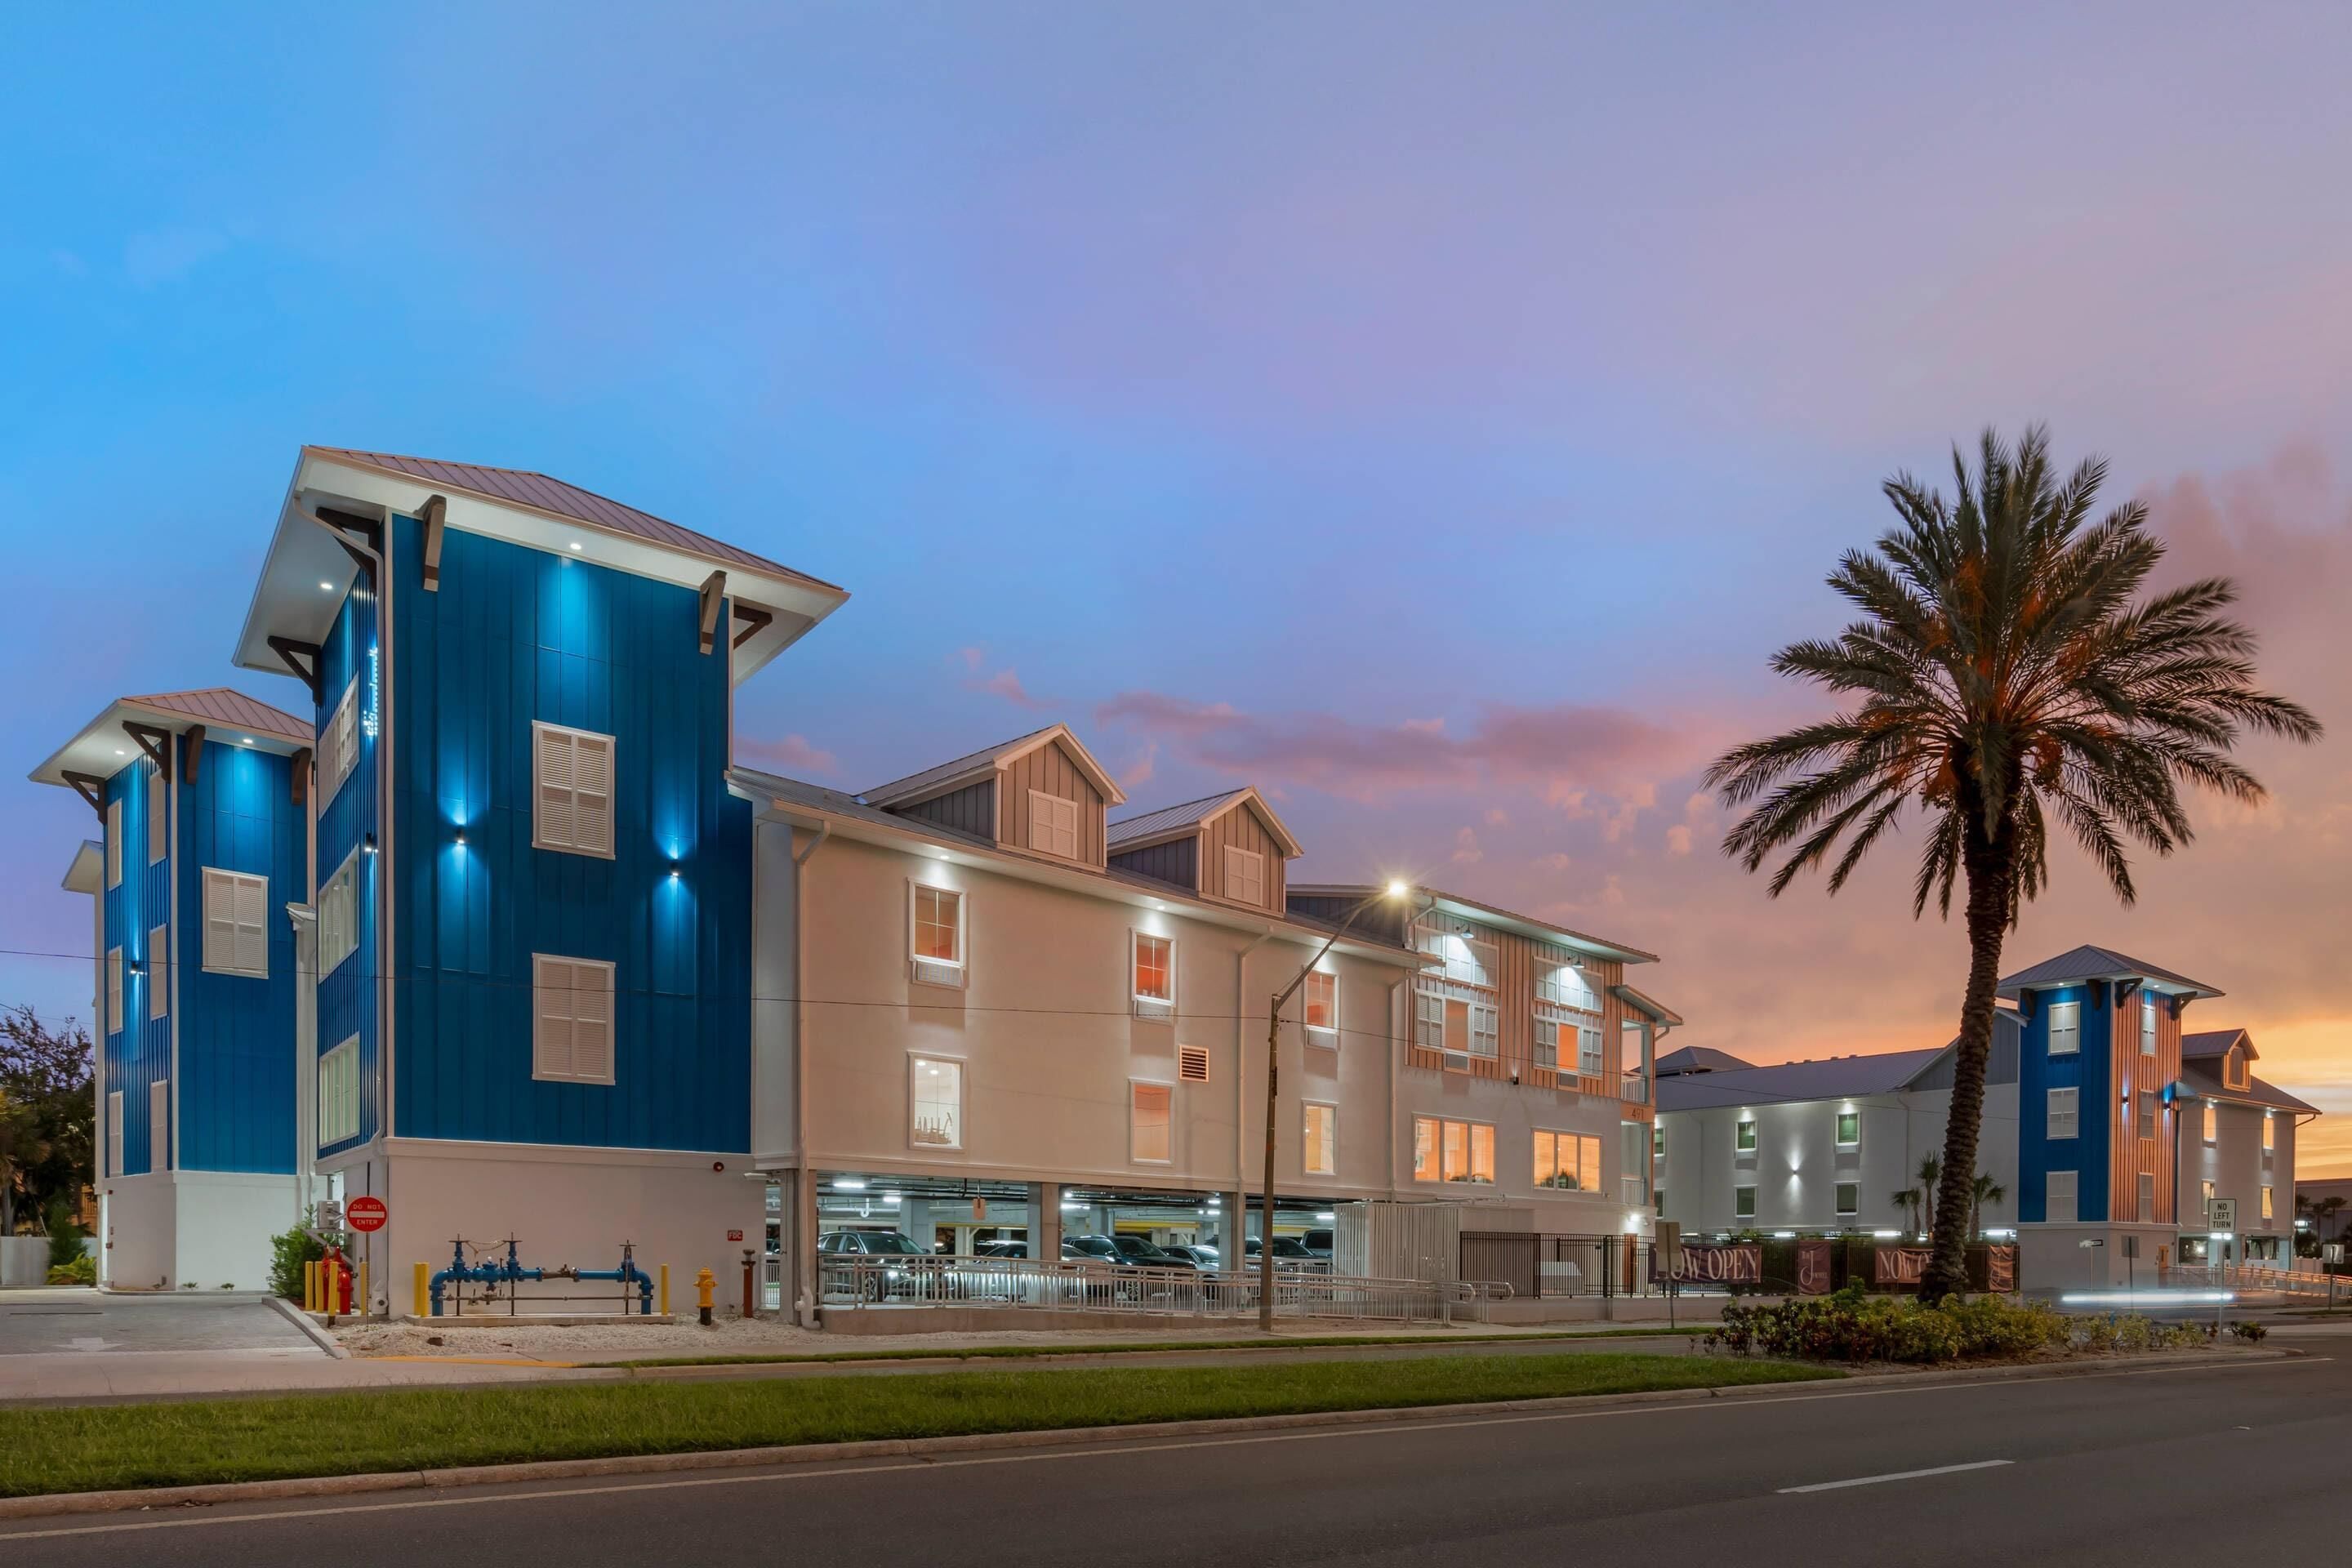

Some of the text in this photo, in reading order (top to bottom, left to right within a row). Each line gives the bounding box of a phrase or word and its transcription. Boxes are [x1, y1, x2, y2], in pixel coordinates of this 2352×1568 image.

[1632, 1107, 1644, 1120] 491
[1654, 1247, 1758, 1280] OW OPEN
[1879, 1250, 1914, 1280] NOW
